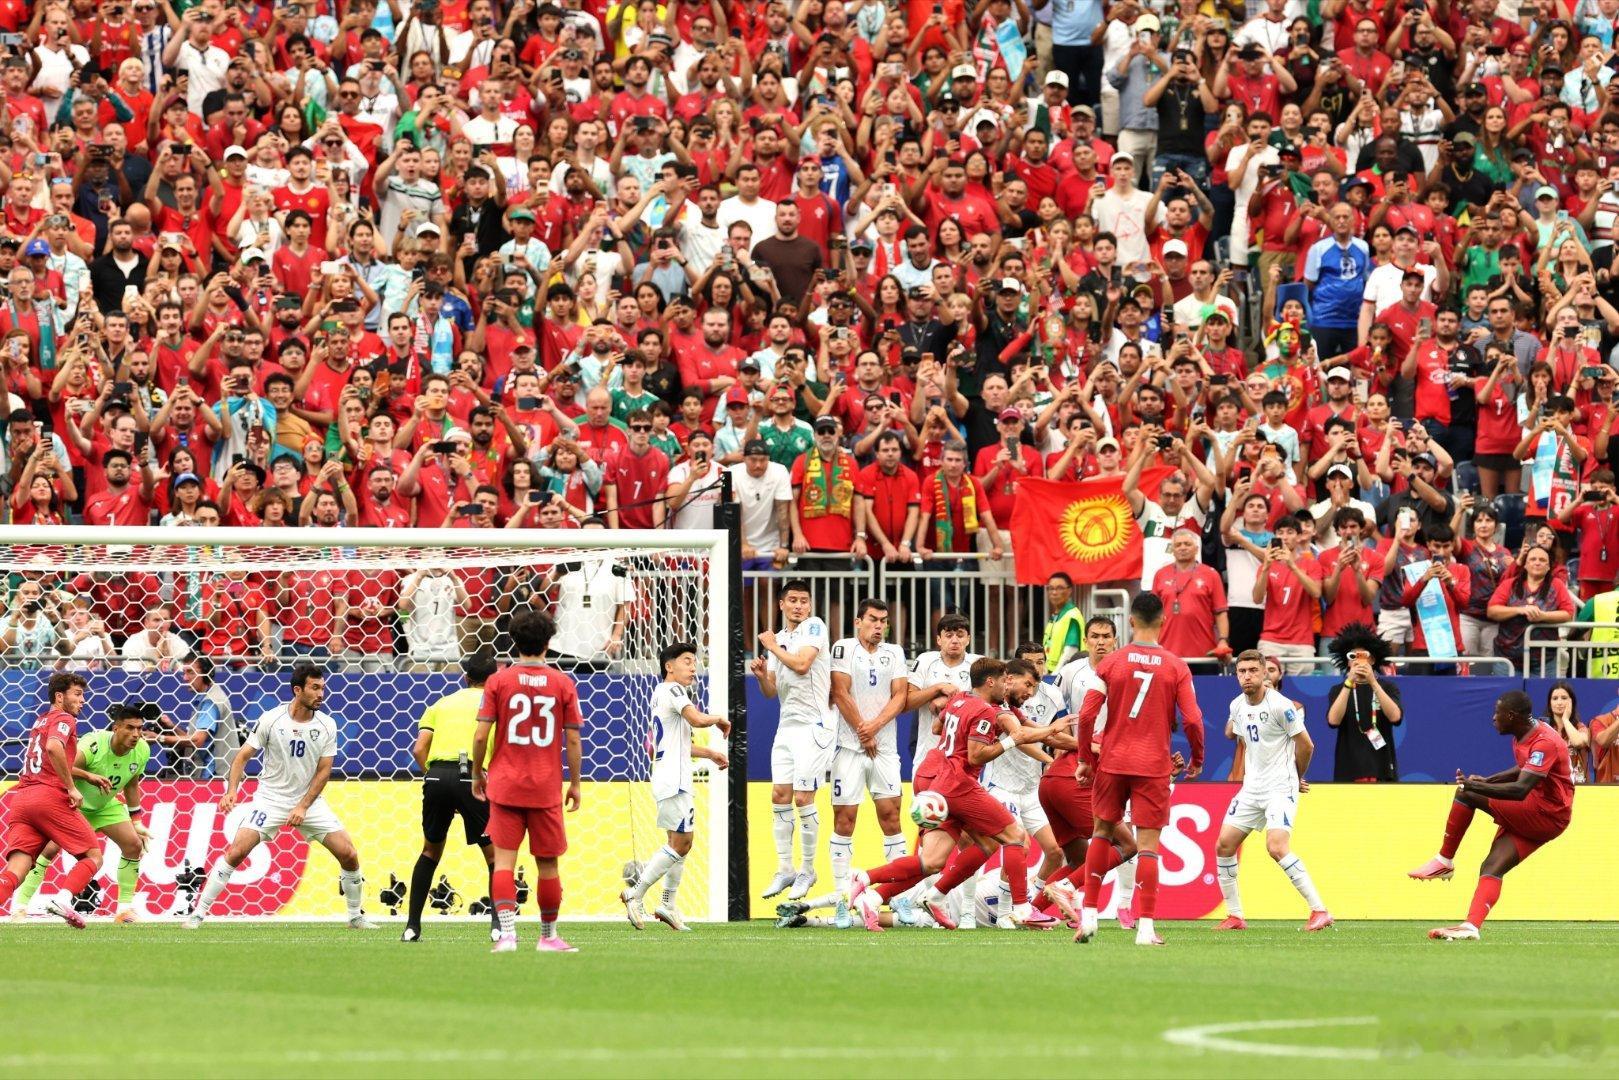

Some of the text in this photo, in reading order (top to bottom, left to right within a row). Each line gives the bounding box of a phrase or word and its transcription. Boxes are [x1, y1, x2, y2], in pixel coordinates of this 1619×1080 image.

[823, 172, 839, 200] 7
[543, 220, 551, 239] 7
[1494, 398, 1502, 416] 7
[632, 480, 642, 500] 7
[1282, 586, 1291, 605] 7
[432, 600, 439, 616] 7
[868, 669, 877, 686] 5
[1128, 670, 1155, 719] 7
[507, 692, 557, 748] 23
[1246, 724, 1259, 742] 13
[289, 739, 306, 761] 18
[834, 779, 841, 797] 5
[249, 809, 267, 827] 18
